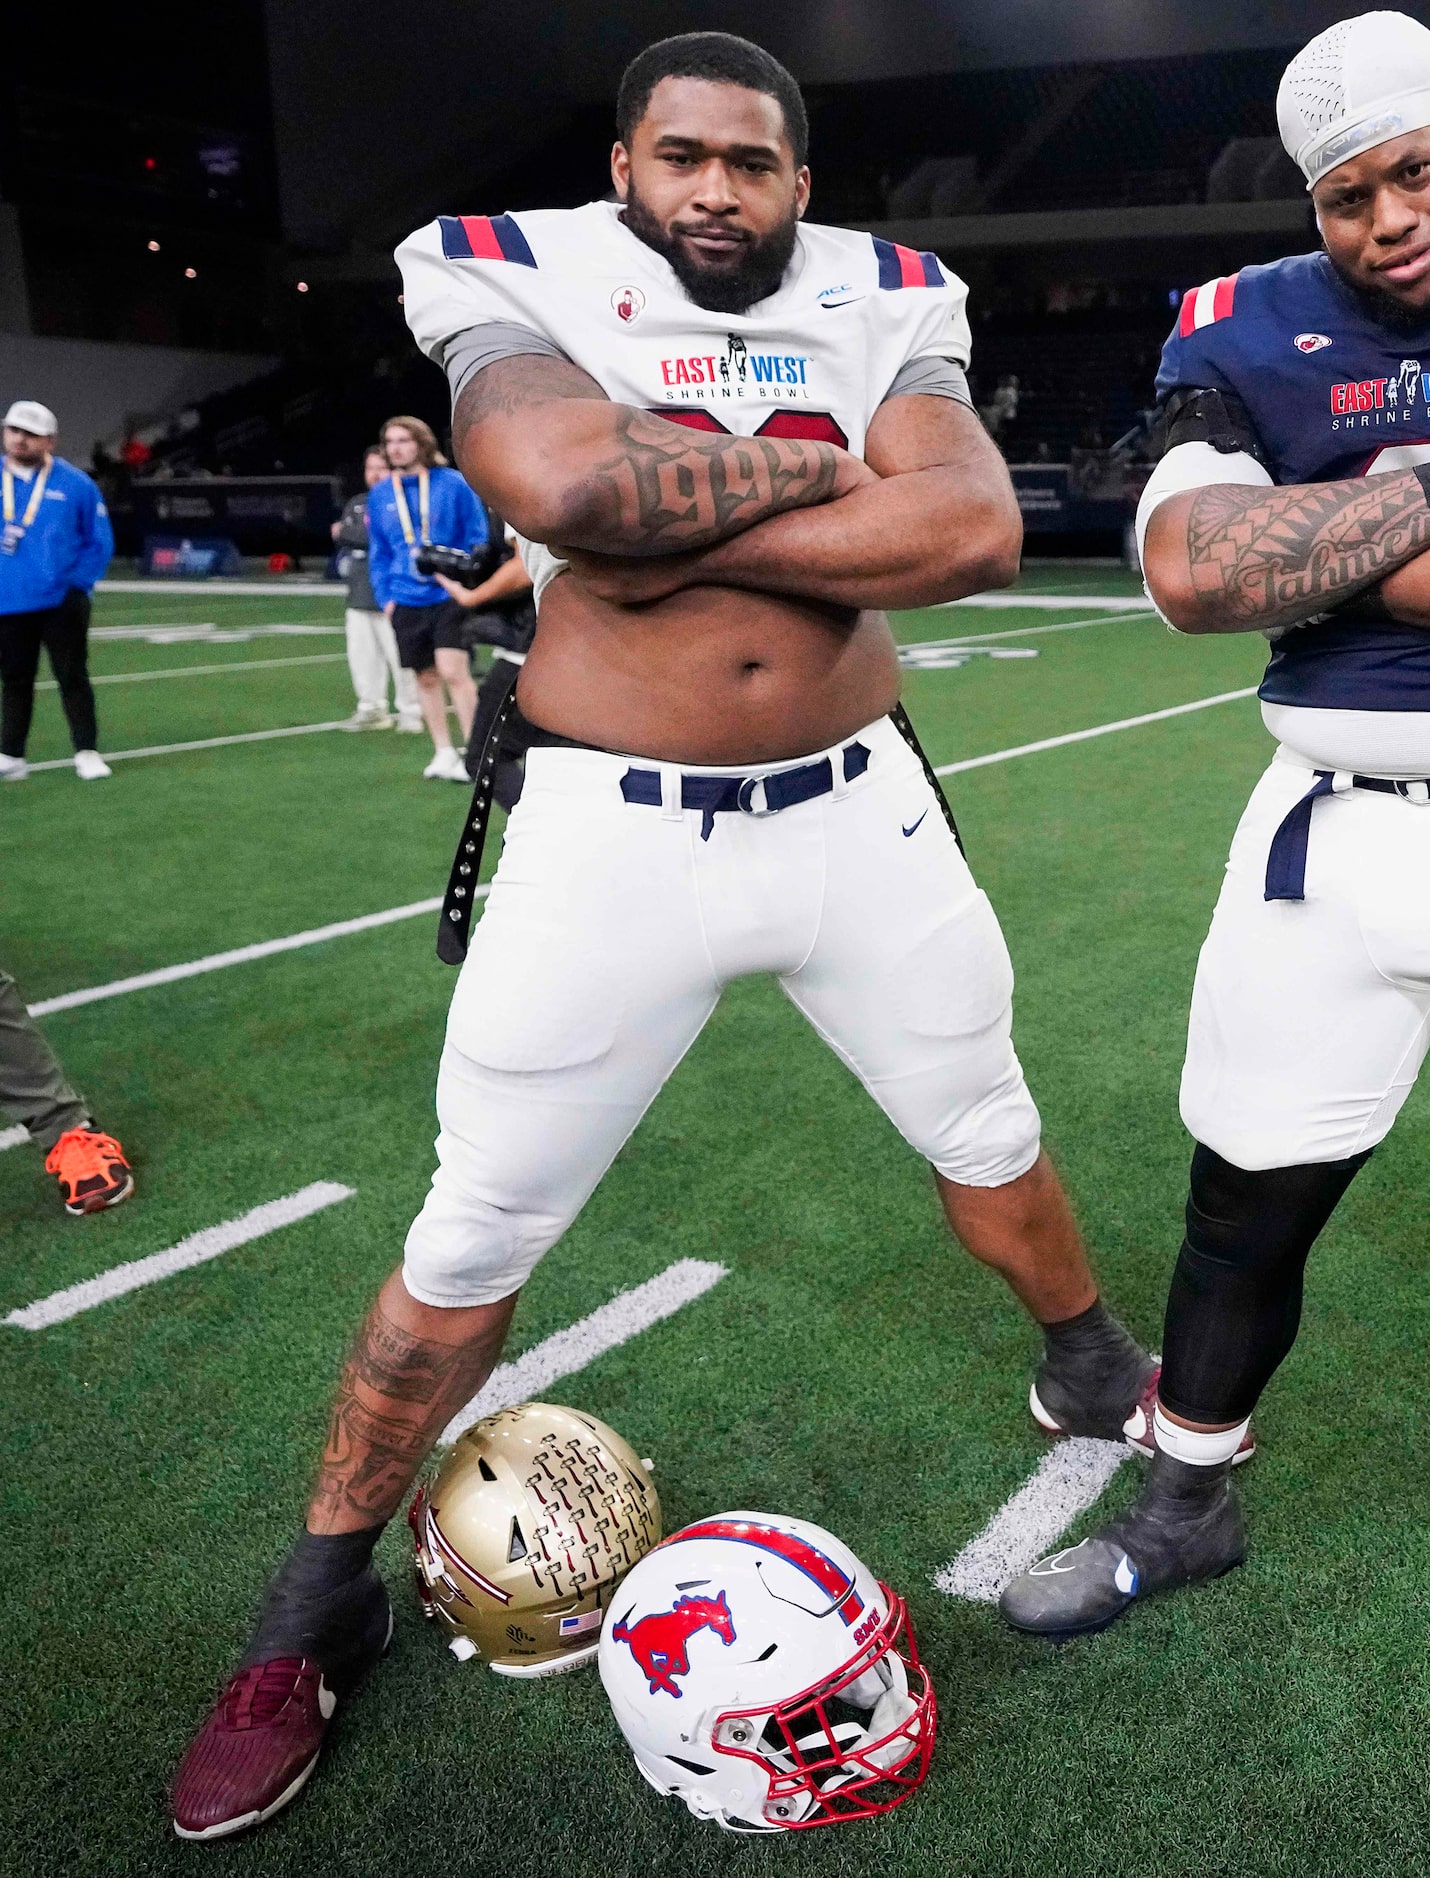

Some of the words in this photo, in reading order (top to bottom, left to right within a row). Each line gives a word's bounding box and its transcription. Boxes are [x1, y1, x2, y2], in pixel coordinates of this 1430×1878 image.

[816, 283, 853, 300] ACC
[660, 356, 717, 386] EAST
[749, 356, 808, 385] WEST
[666, 388, 745, 400] SHRINE
[759, 387, 810, 399] BOWL
[1330, 377, 1389, 416] EAST
[1331, 409, 1412, 431] SHRINE
[853, 1606, 881, 1646] SMU
